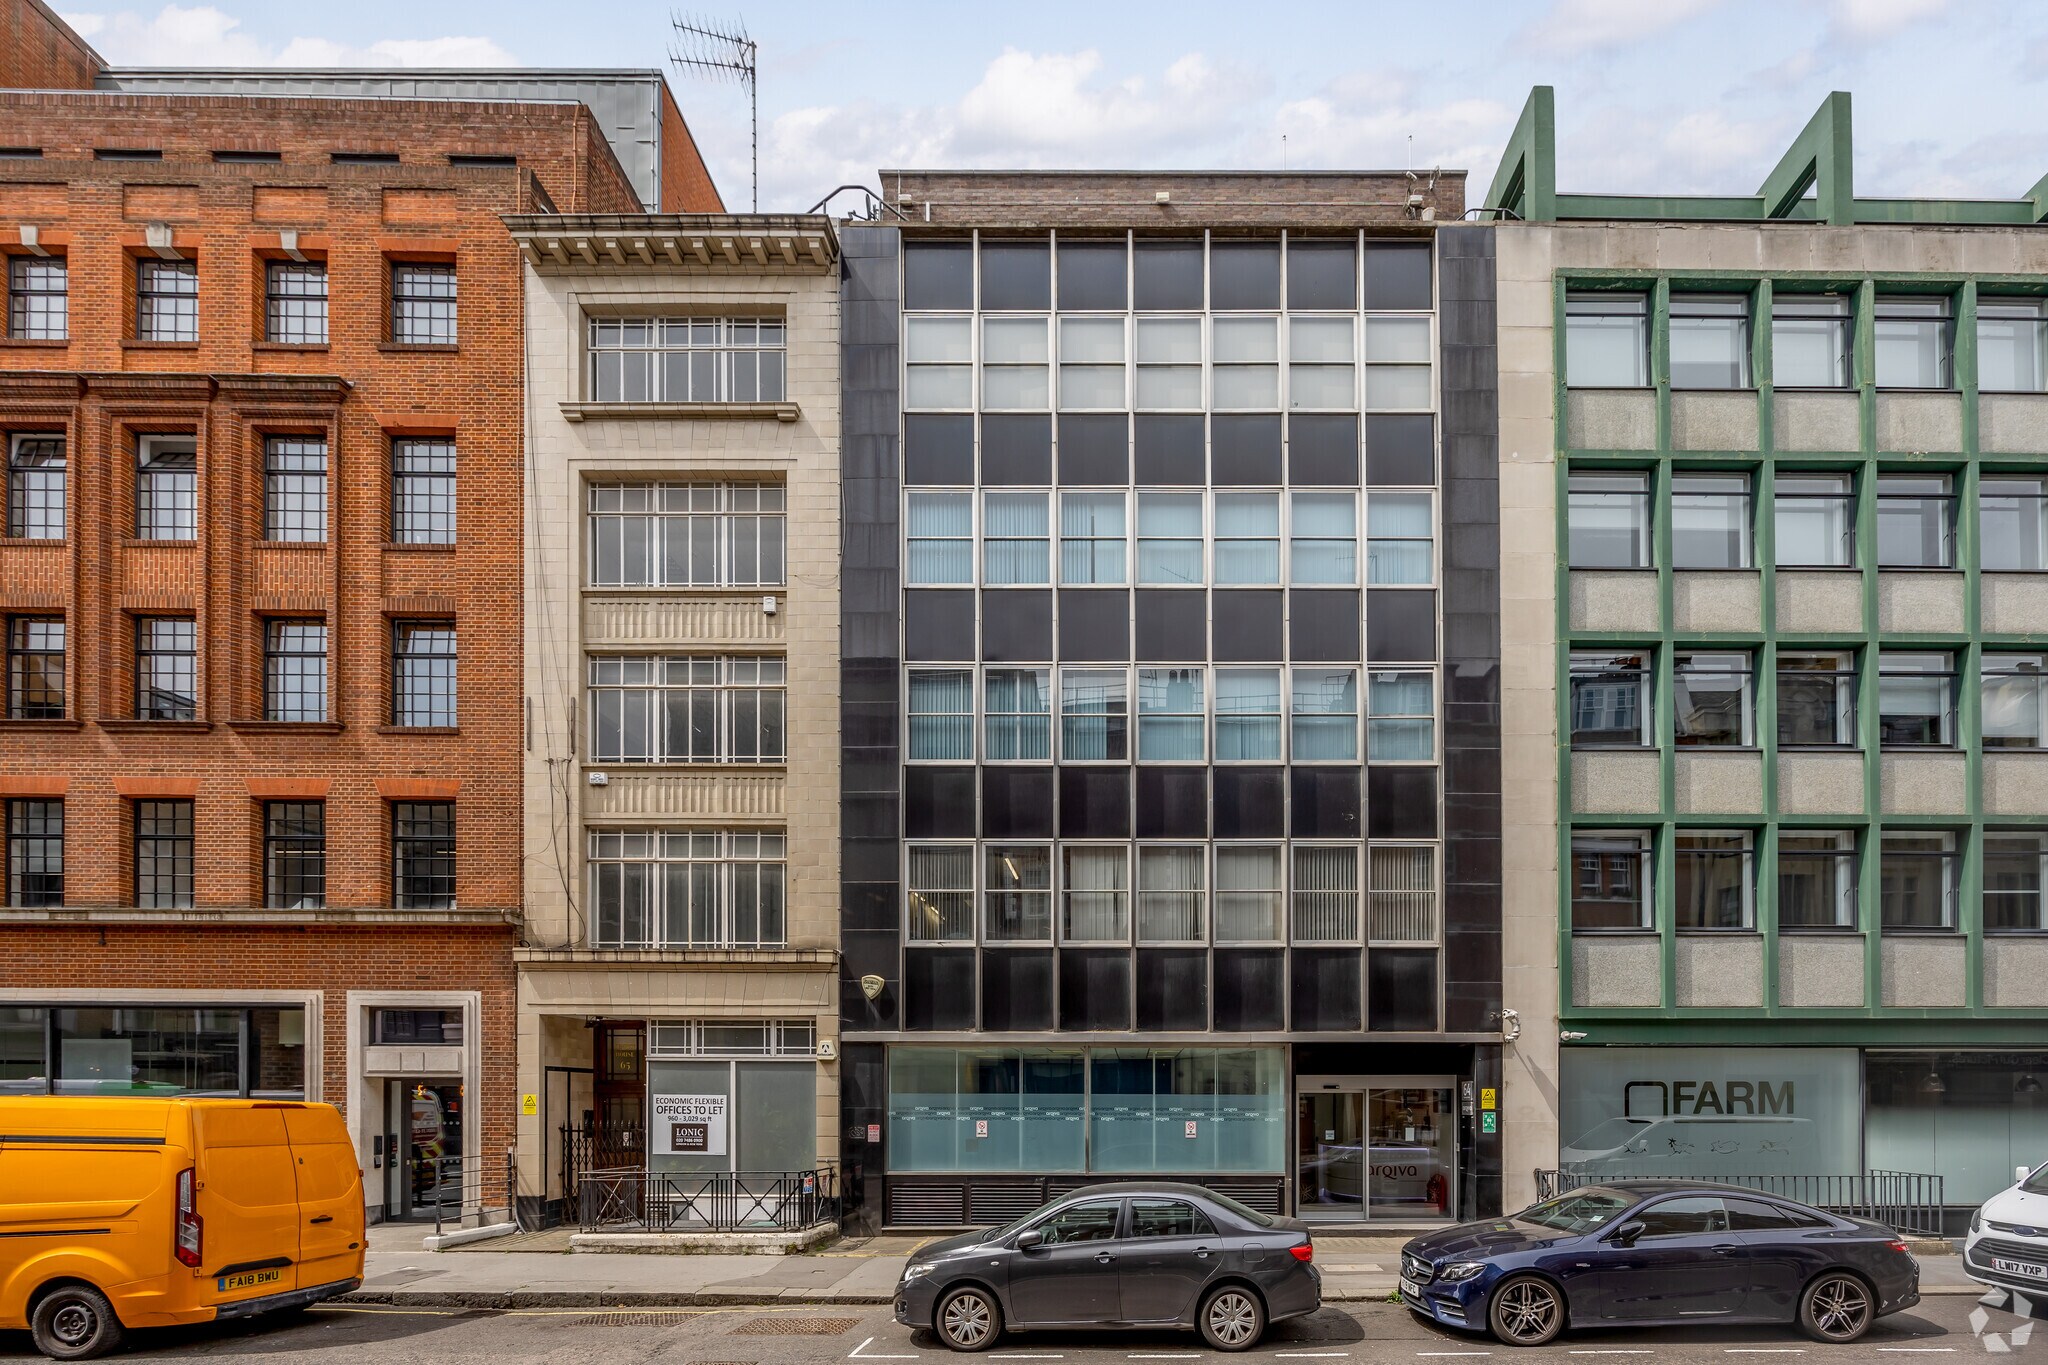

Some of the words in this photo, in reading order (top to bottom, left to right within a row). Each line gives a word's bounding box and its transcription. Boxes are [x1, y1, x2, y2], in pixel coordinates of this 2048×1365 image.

[620, 1061, 631, 1070] 65
[1673, 1081, 1794, 1114] FARM
[656, 1106, 692, 1114] OFFICES
[694, 1106, 706, 1114] TO
[708, 1106, 723, 1115] LET
[676, 1128, 704, 1136] LONIC
[1369, 1165, 1417, 1180] arqiva
[2022, 1264, 2042, 1275] VXP
[229, 1275, 254, 1288] FA18
[258, 1271, 279, 1282] BWU
